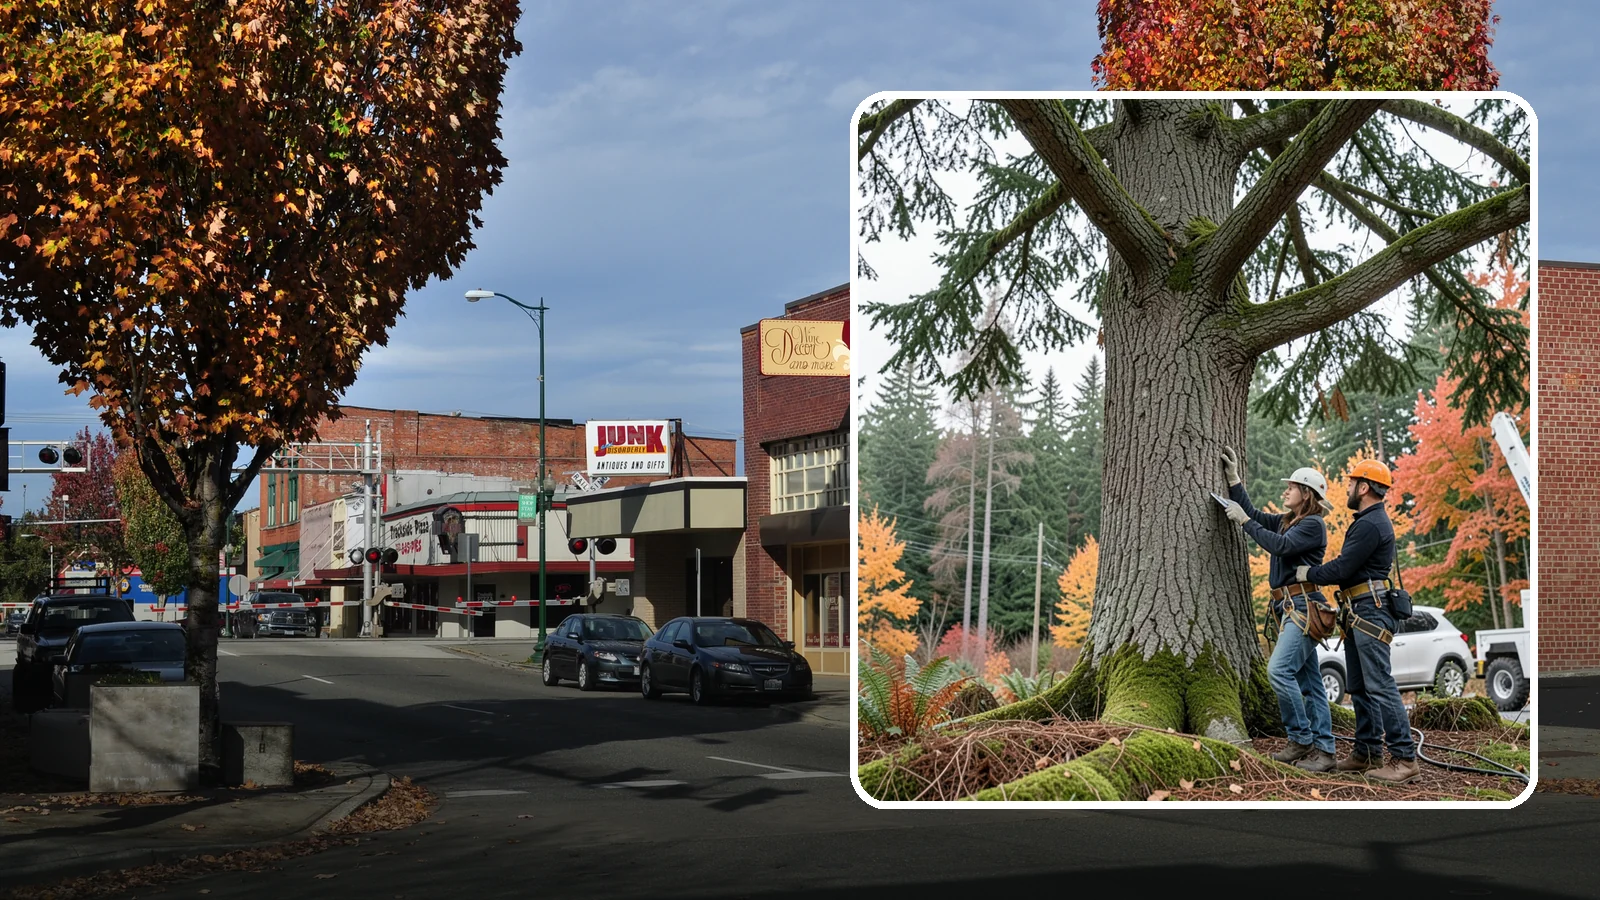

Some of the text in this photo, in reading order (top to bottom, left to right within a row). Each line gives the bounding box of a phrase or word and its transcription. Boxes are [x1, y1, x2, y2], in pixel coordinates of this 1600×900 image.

[596, 425, 664, 457] JUNK
[607, 446, 646, 454] DISORDERLY
[597, 460, 665, 470] ANTIQUES AND GIFTS
[390, 519, 429, 539] Trackside Pizza
